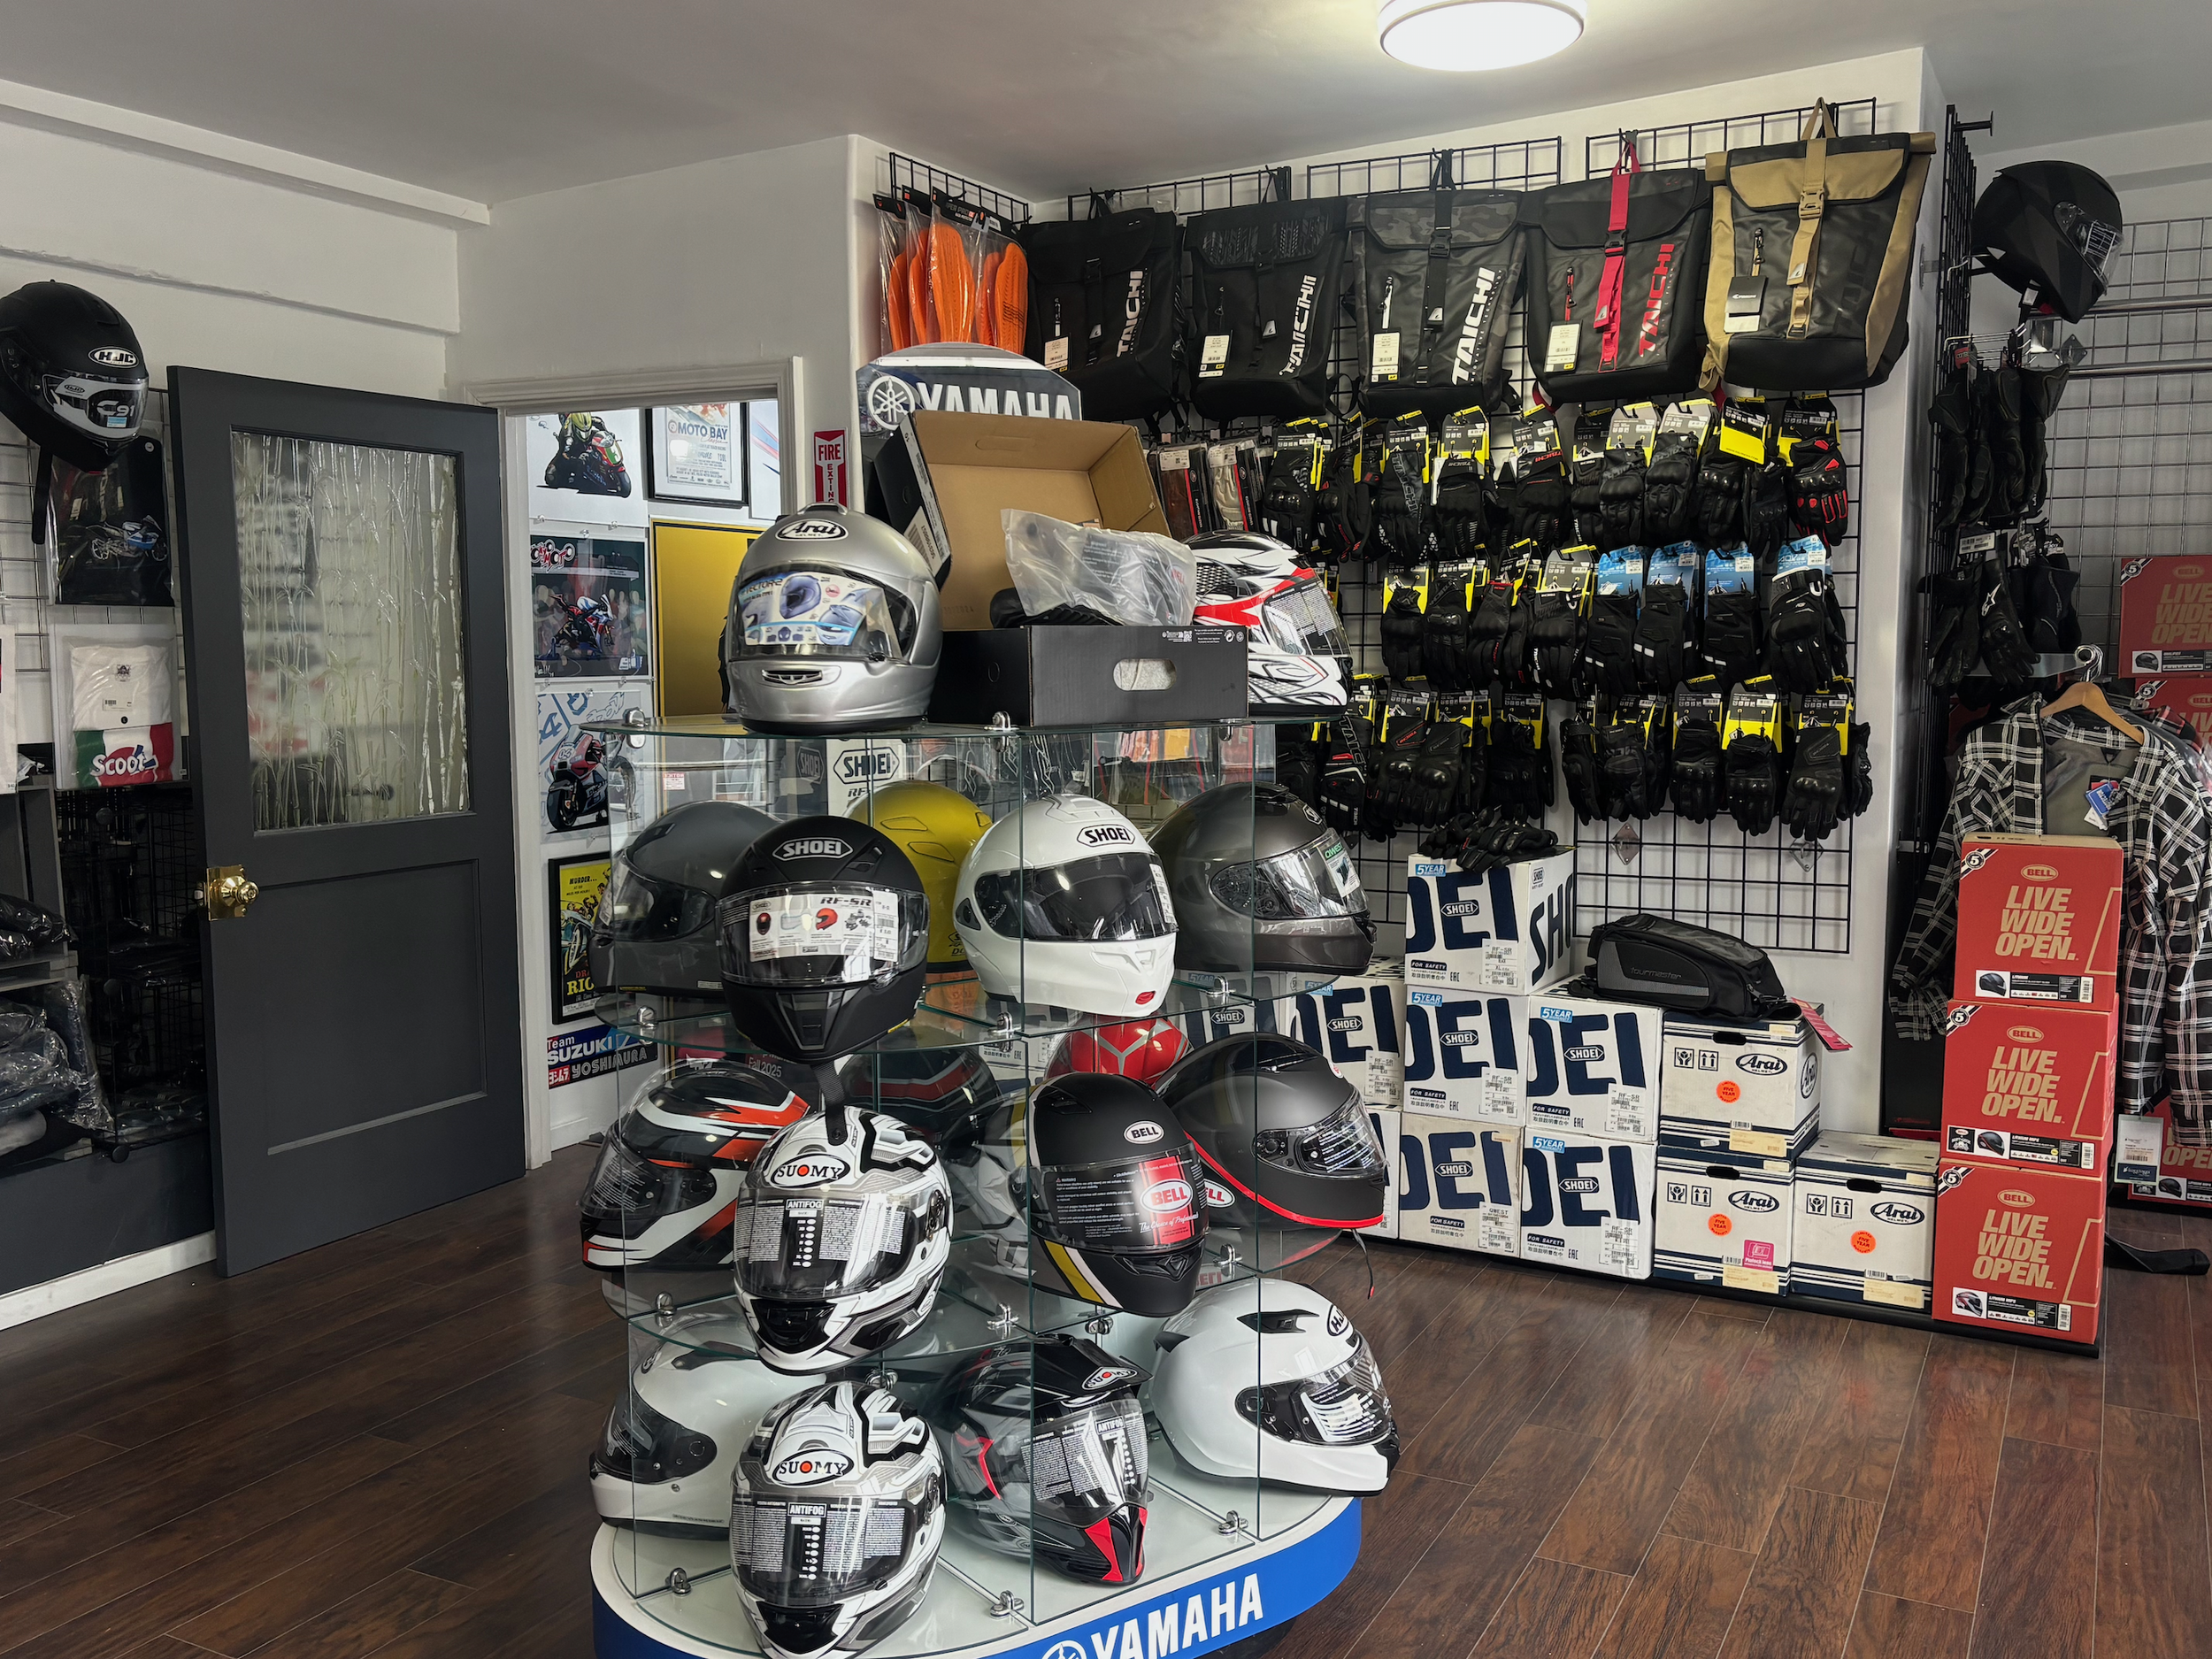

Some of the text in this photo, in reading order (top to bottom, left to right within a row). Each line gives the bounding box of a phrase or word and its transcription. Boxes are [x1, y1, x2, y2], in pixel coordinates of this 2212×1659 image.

[1640, 244, 1674, 357] TAICHI
[1451, 267, 1495, 386] TAICHI
[99, 351, 134, 364] HJC
[917, 381, 1073, 420] YAMAHA
[97, 400, 134, 417] C91
[678, 422, 727, 440] MOTO BAY
[818, 443, 841, 461] FIRE
[787, 520, 841, 534] Arai
[2143, 687, 2152, 695] 5
[843, 753, 892, 778] SHOEI
[1085, 827, 1130, 844] SHOEI
[782, 841, 842, 858] SHOEI
[1970, 856, 1980, 864] 5
[820, 896, 872, 906] RF-SR
[2006, 886, 2071, 911] LIVE
[1446, 902, 1475, 915] SHOEI
[2001, 909, 2075, 935] WIDE
[1995, 933, 2076, 961] OPEN.
[1425, 962, 1447, 971] SAFETY
[1216, 1012, 1240, 1022] SHOEI
[1333, 1019, 1358, 1029] SHOEI
[1955, 1013, 1964, 1022] 5
[1446, 1033, 1473, 1044] SHOEI
[2013, 1030, 2039, 1039] BELL
[547, 1036, 575, 1050] Team
[547, 1036, 612, 1065] SUZUKI
[1570, 1048, 1599, 1059] SHOEI
[1992, 1046, 2057, 1073] LIVE
[572, 1047, 647, 1079] YOSHIMURA
[761, 1062, 782, 1078] 2025
[1743, 1056, 1782, 1070] Arai
[1986, 1069, 2061, 1098] WIDE
[1981, 1092, 2062, 1124] OPEN.
[1131, 1126, 1159, 1139] BELL
[776, 1164, 842, 1179] SUOMY
[1440, 1164, 1467, 1174] SHOEI
[1564, 1181, 1593, 1191] SHOEI
[1948, 1174, 1956, 1183] 5
[1152, 1187, 1187, 1205] BELL
[1737, 1193, 1773, 1208] Arai
[2003, 1194, 2030, 1203] BELL
[1878, 1204, 1918, 1220] Arai
[1139, 1222, 1151, 1233] The
[1444, 1219, 1464, 1228] SAFETY
[1983, 1209, 2049, 1240] LIVE
[1542, 1237, 1564, 1246] SAFETY
[1977, 1232, 2052, 1263] WIDE
[1972, 1256, 2054, 1289] OPEN.
[1331, 1310, 1348, 1333] HJ
[1097, 1419, 1123, 1433] ANTIFOG
[780, 1460, 847, 1477] SUOMY
[790, 1505, 825, 1516] ANTIFOG
[1091, 1572, 1263, 1659] YAMAHA
